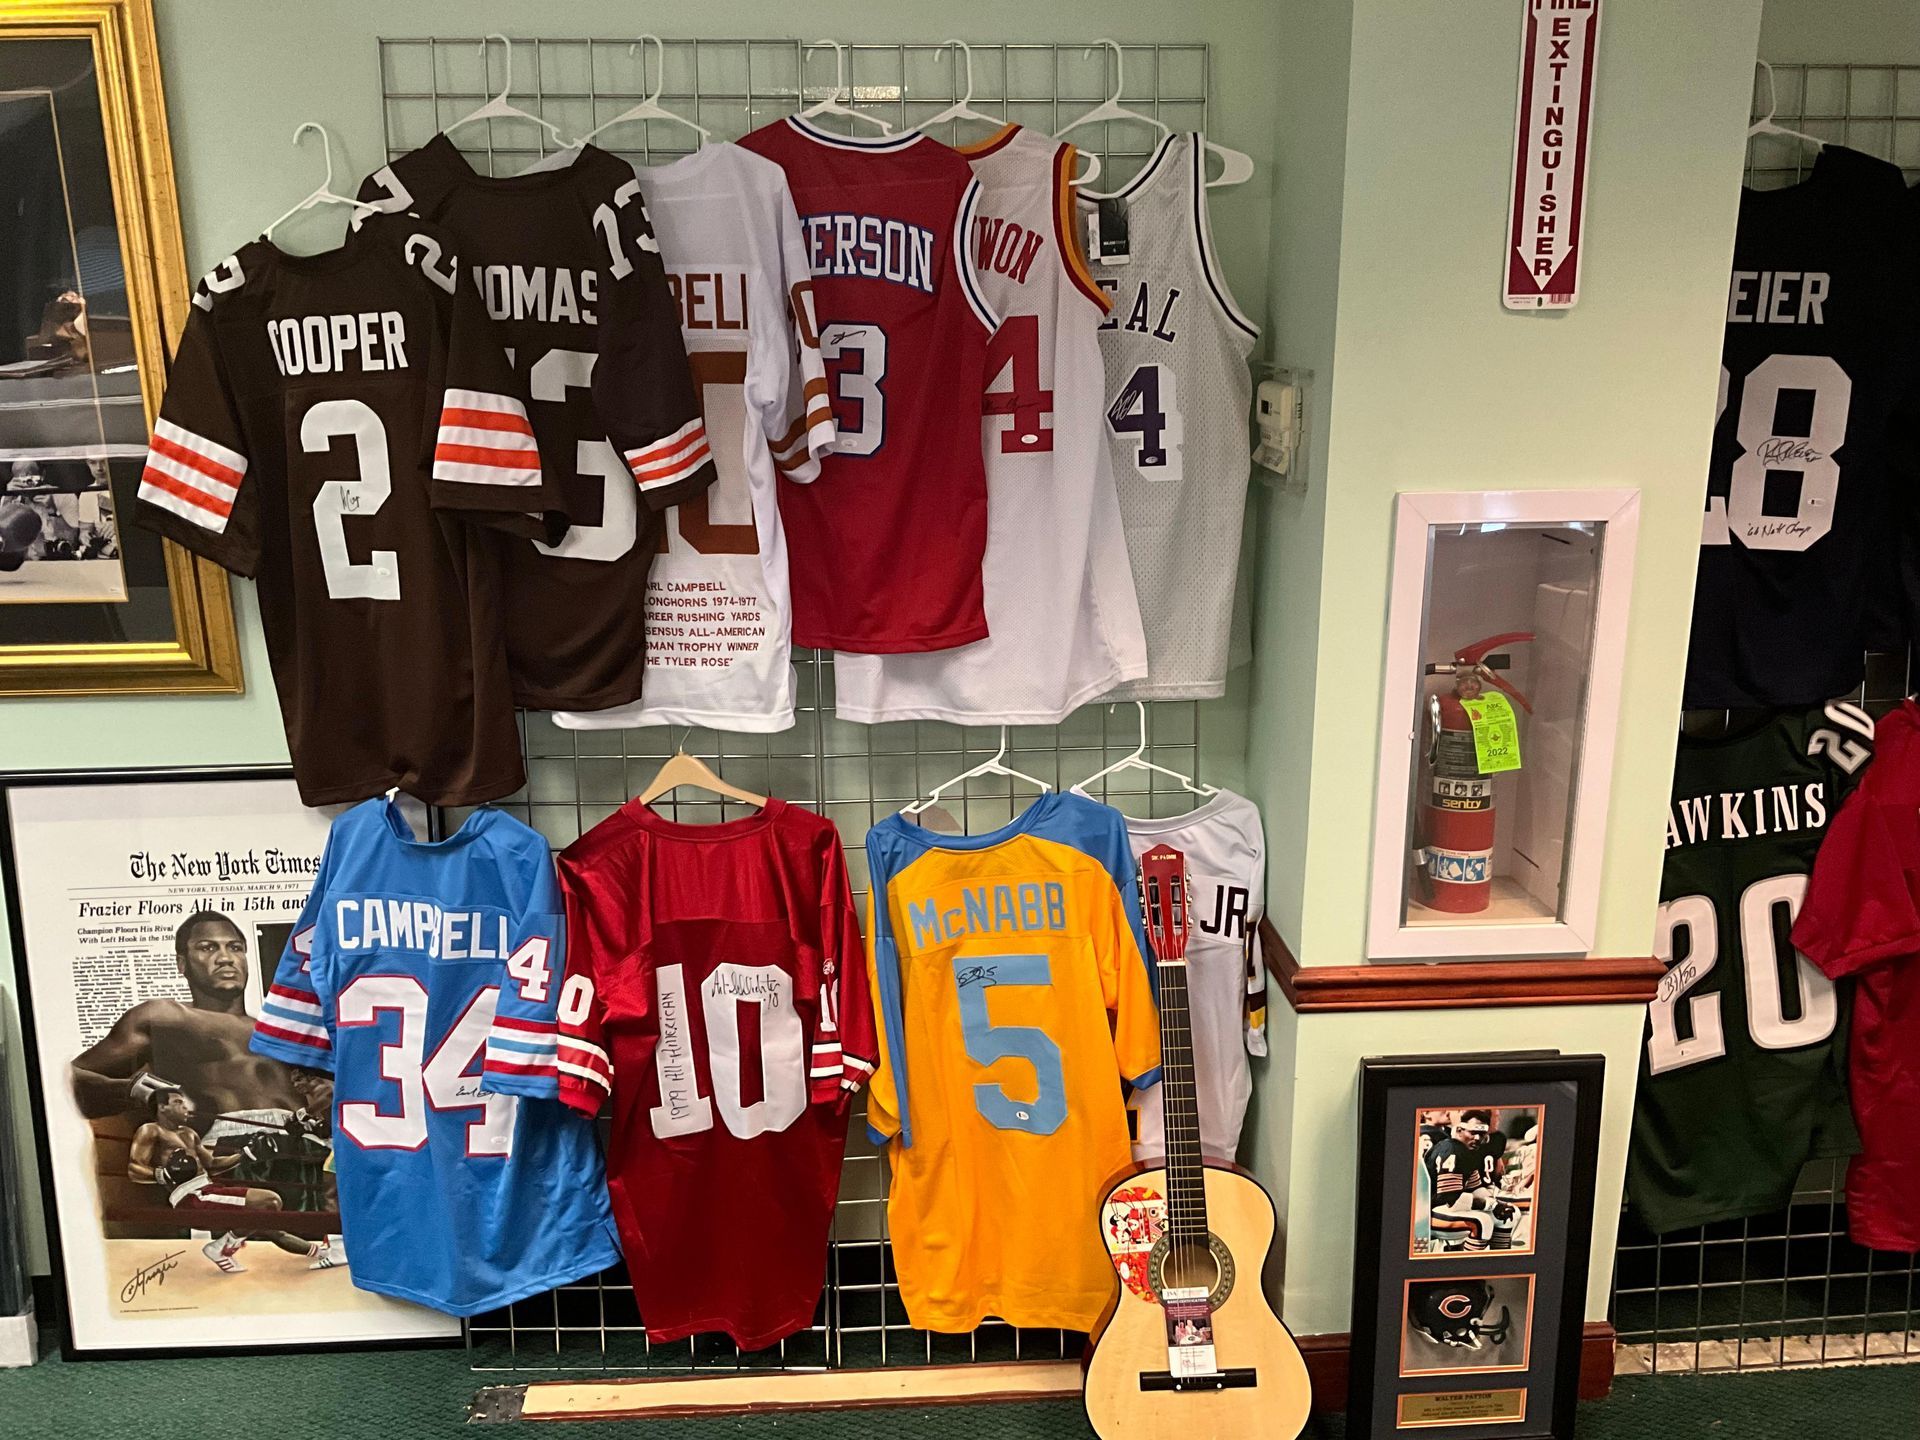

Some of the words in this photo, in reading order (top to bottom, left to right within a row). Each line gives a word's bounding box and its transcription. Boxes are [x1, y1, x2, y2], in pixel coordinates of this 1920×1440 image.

[1534, 17, 1571, 276] EXTINGUISHER
[800, 214, 934, 293] ERSON
[971, 215, 1044, 284] WON
[473, 264, 598, 325] OMAS
[1727, 270, 1831, 325] EIER
[819, 320, 891, 457] 3
[503, 348, 636, 562] 3
[1700, 353, 1852, 552] 8
[300, 399, 402, 600] 2
[667, 581, 726, 592] CAMPBELL
[712, 596, 757, 607] 1974-1977
[677, 612, 725, 622] RUSHING
[731, 611, 761, 621] YARDS
[688, 627, 765, 637] ALL-AMERICAN
[664, 656, 697, 667] TYLER
[678, 642, 722, 651] TROPHY
[727, 642, 759, 651] WINNER
[1486, 747, 1508, 757] 2022
[130, 851, 167, 882] The
[171, 852, 212, 881] New
[215, 848, 260, 882] York
[264, 847, 321, 876] Times
[247, 884, 275, 892] MARCH
[77, 927, 114, 937] Champion
[115, 926, 139, 934] Floors
[140, 925, 153, 933] His
[154, 924, 174, 933] Rival
[78, 901, 132, 918] Frazier
[138, 899, 183, 915] Floors
[189, 898, 212, 913] Ali
[221, 897, 236, 912] in
[243, 896, 275, 911] 15th
[282, 894, 308, 909] and
[79, 936, 99, 944] With
[100, 935, 117, 943] Left
[118, 935, 138, 943] Hook
[147, 934, 160, 942] the
[161, 933, 176, 942] 15th
[506, 935, 552, 1003] 4
[1647, 872, 1838, 1076] 20
[336, 973, 519, 1157] 34
[650, 962, 807, 1140] 10
[952, 953, 1069, 1136] 5
[669, 1089, 691, 1121] 1979
